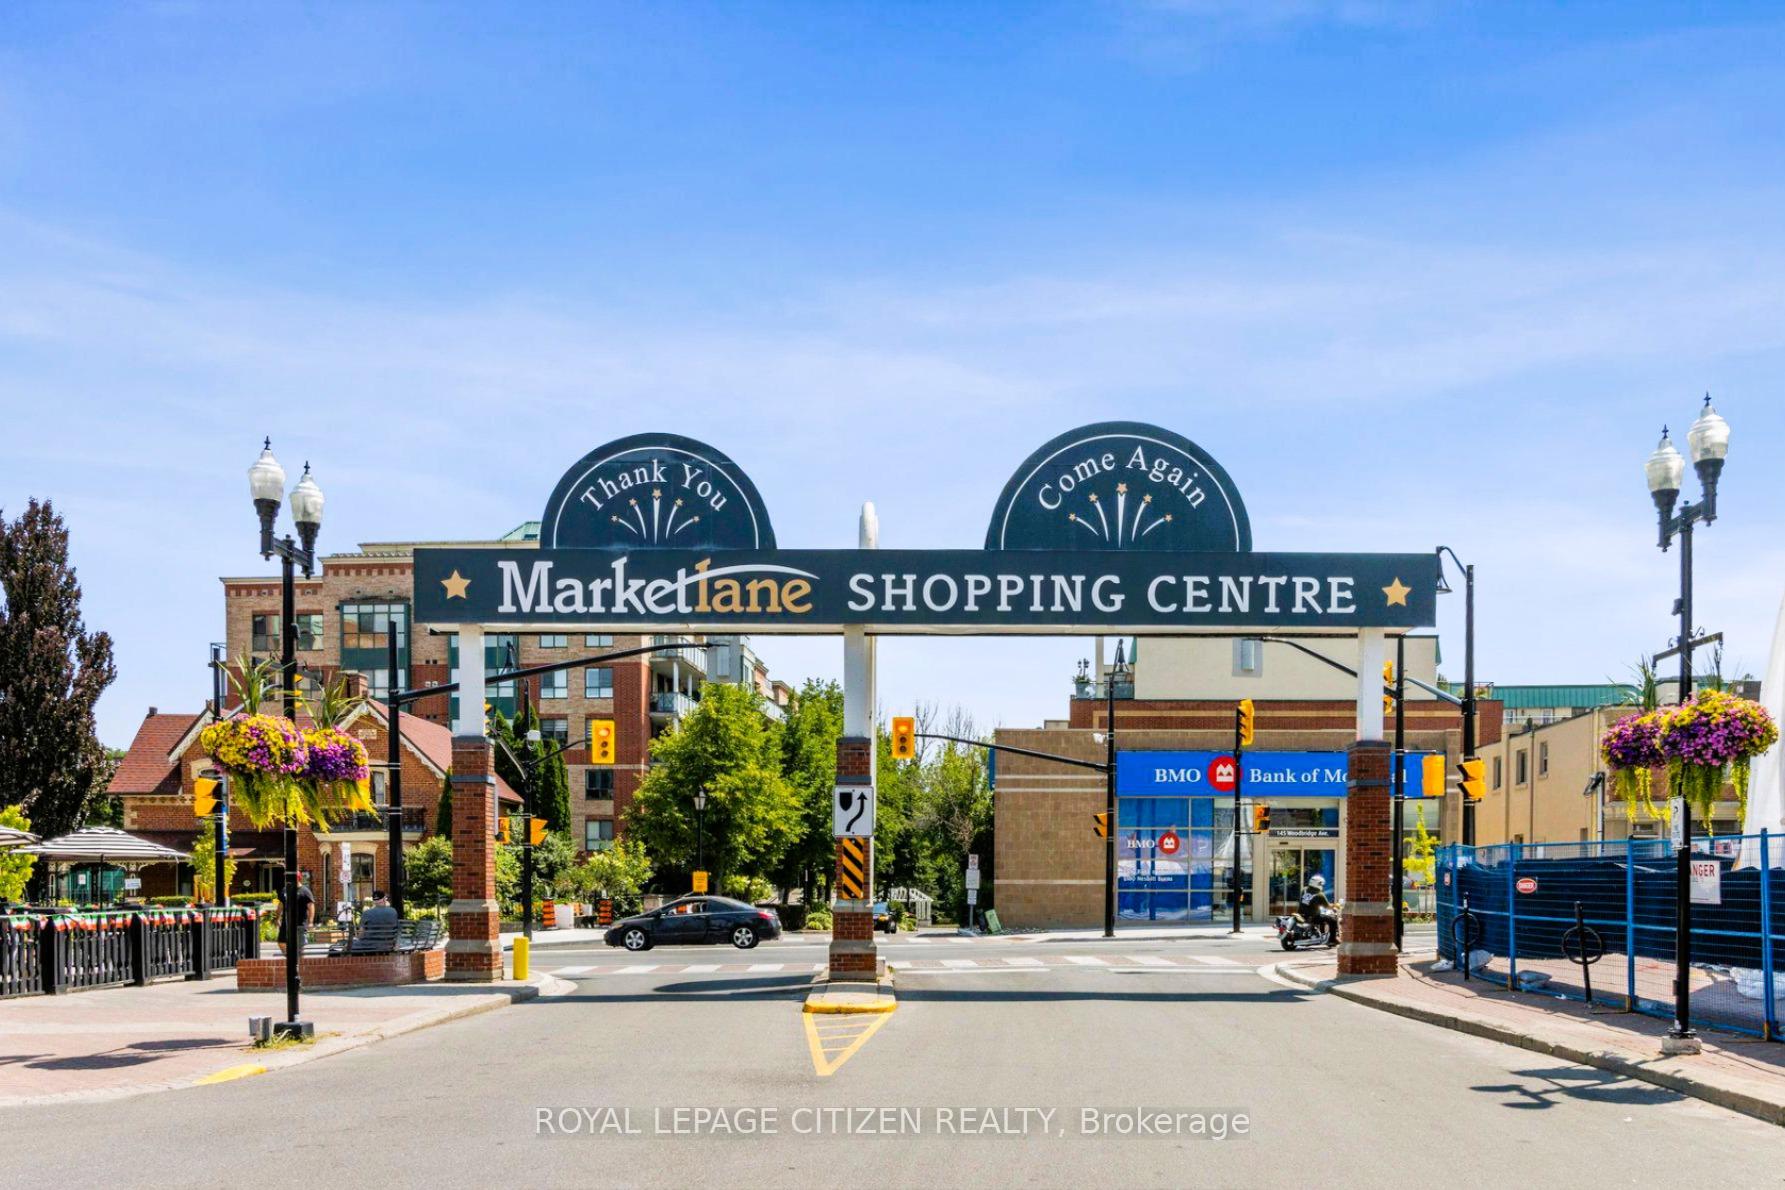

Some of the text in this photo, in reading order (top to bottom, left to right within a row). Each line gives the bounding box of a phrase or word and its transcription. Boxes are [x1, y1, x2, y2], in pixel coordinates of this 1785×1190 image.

[580, 458, 727, 512] Thank You
[1037, 444, 1206, 511] Come Again
[497, 556, 1357, 615] Marketlane SHOPPING CENTRE
[1154, 768, 1201, 783] BMO
[1249, 767, 1297, 783] Bank
[1301, 767, 1320, 783] of
[1127, 839, 1155, 849] BMO
[1692, 864, 1716, 877] NGER
